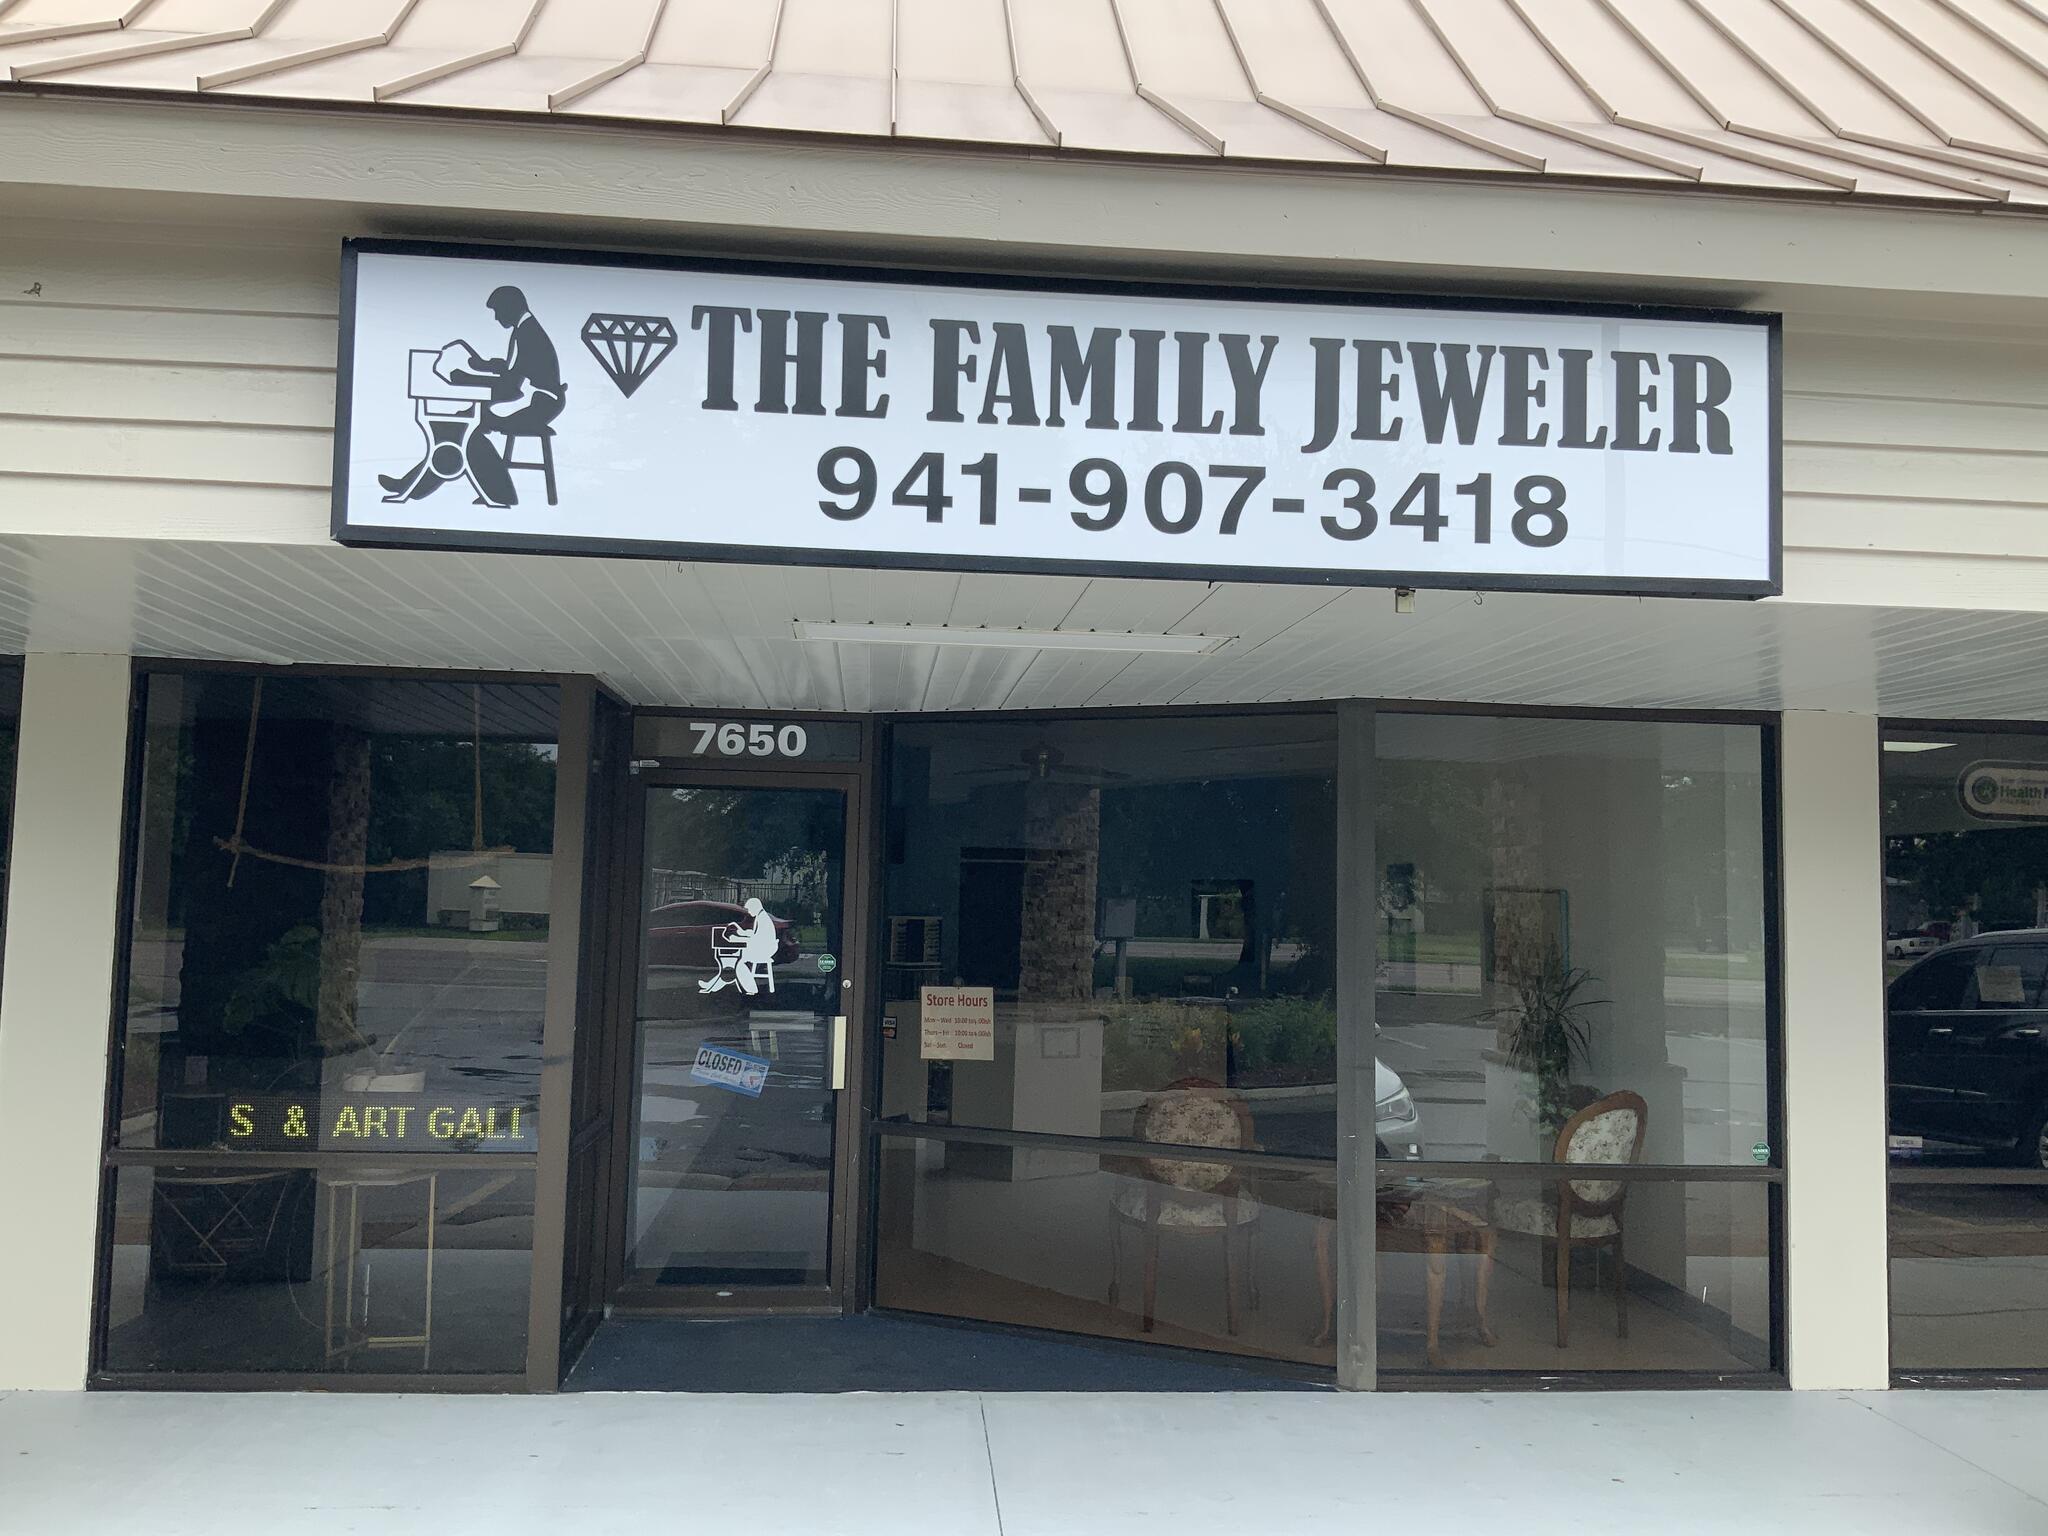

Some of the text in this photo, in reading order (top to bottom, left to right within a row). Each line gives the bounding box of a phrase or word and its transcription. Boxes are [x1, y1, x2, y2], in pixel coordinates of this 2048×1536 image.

[691, 305, 1734, 455] THE FAMILY JEWELER
[816, 445, 1569, 548] 941-907-3418
[689, 722, 807, 757] 7650
[2000, 785, 2042, 799] Health
[926, 993, 988, 1007] Store Hours
[698, 1050, 742, 1076] CLOSED
[229, 1104, 255, 1136] S
[282, 1105, 309, 1138] &
[332, 1106, 416, 1139] ART
